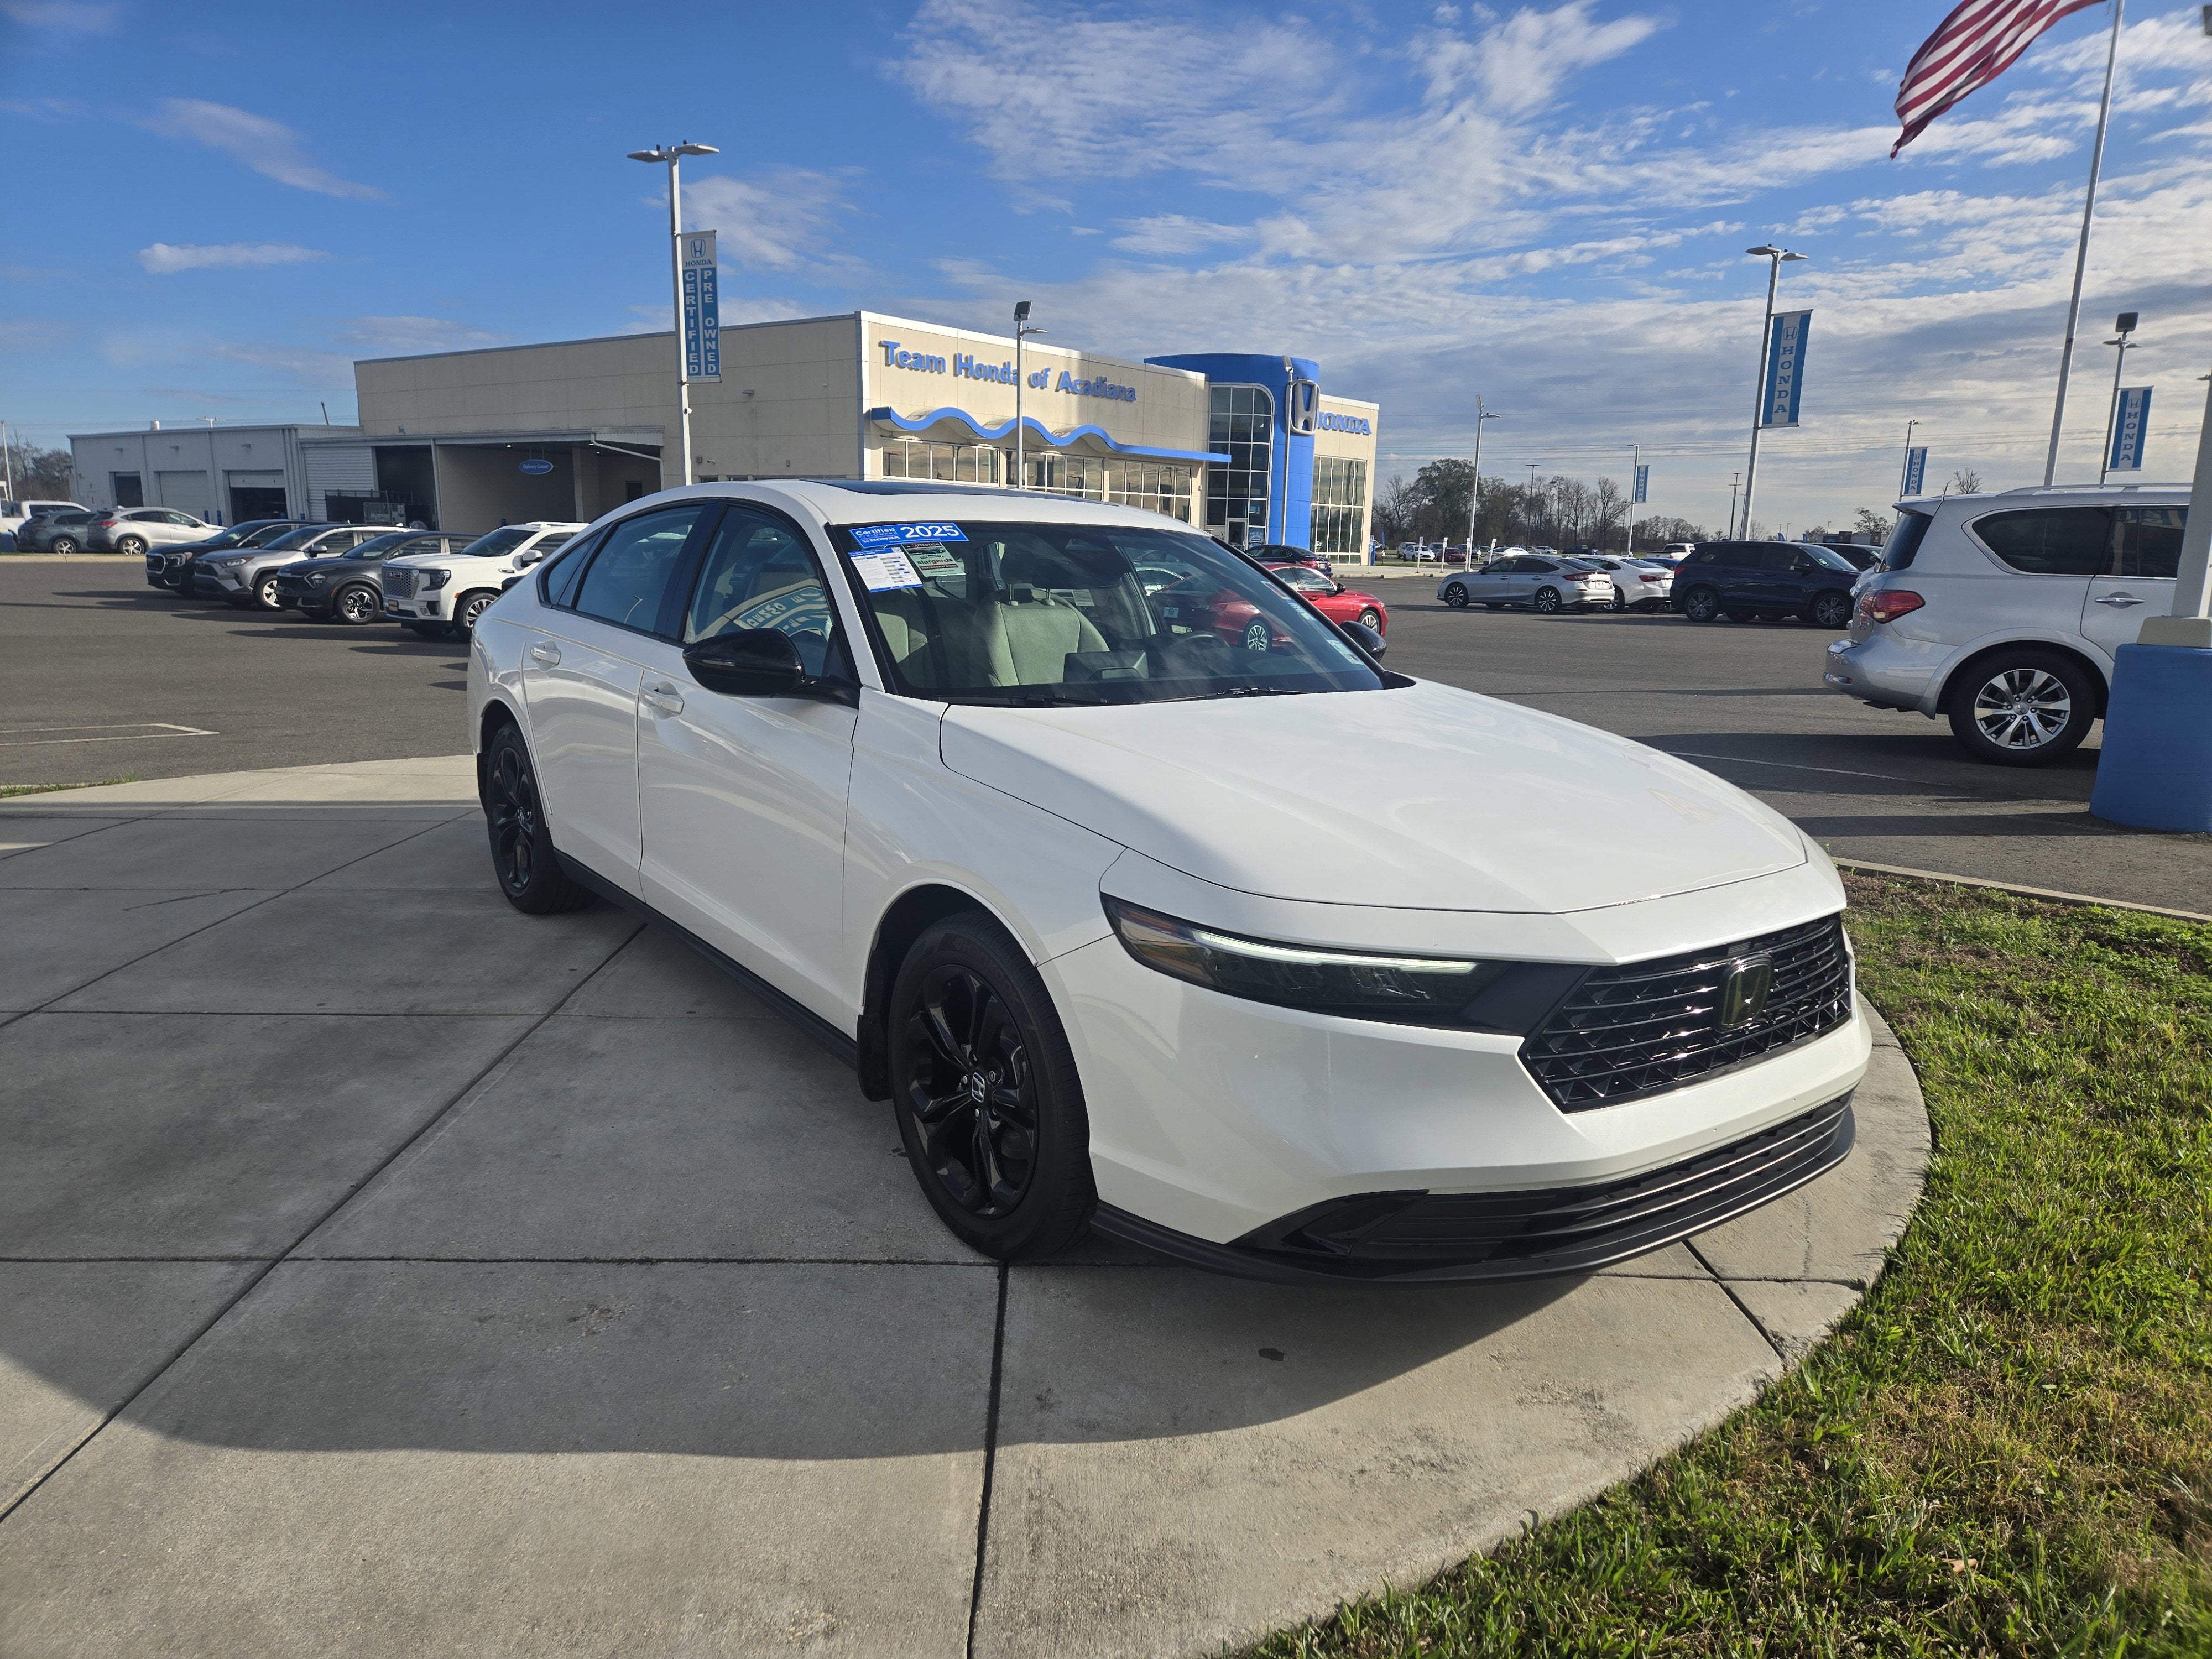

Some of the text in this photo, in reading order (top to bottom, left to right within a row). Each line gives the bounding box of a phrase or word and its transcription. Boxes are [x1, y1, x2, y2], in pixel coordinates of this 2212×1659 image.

[703, 270, 713, 304] PRE
[685, 271, 698, 374] CERTIFIED
[704, 317, 717, 373] OWNED
[880, 340, 946, 374] Team
[1029, 367, 1051, 389] of
[1056, 371, 1137, 402] Acadiana
[1774, 346, 1794, 413] HONDA
[2120, 411, 2139, 461] HONDA
[1910, 461, 1919, 490] HONDA
[855, 527, 895, 535] Certified
[900, 525, 959, 538] 2025
